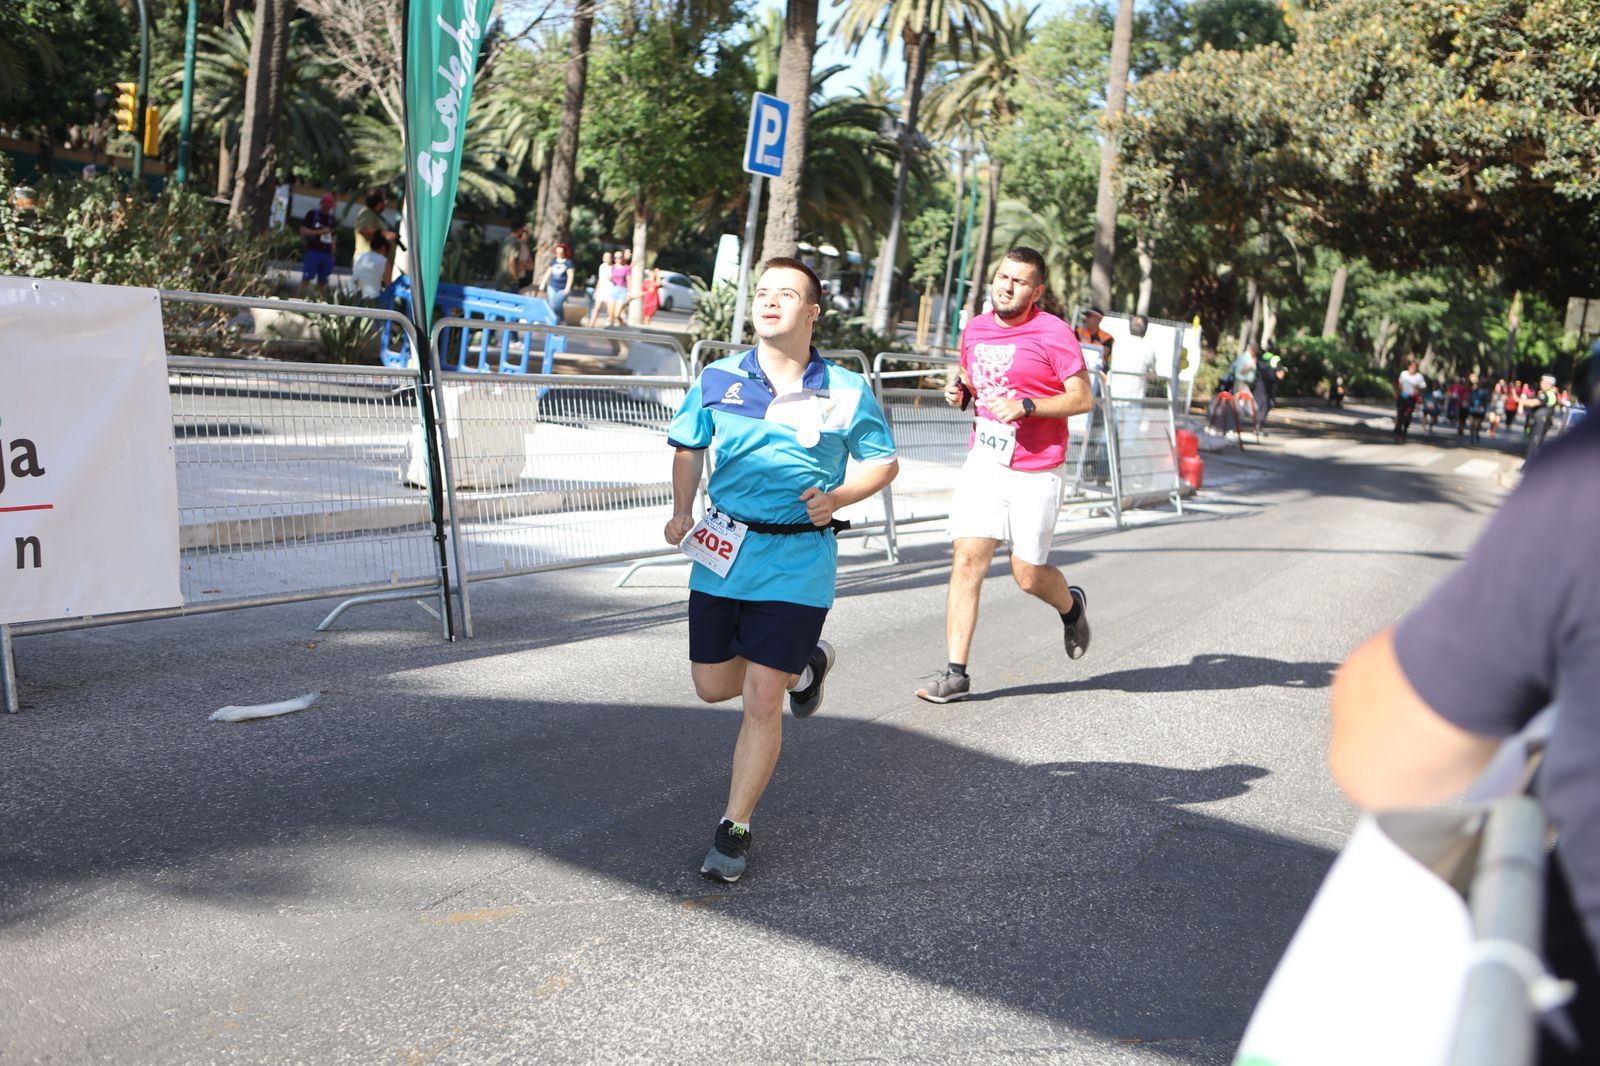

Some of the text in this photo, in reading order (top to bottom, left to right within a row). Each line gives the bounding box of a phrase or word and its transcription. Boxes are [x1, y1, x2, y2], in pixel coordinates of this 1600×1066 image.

[755, 104, 782, 164] P
[979, 431, 1008, 452] 447
[15, 535, 42, 570] n
[693, 527, 734, 561] 402
